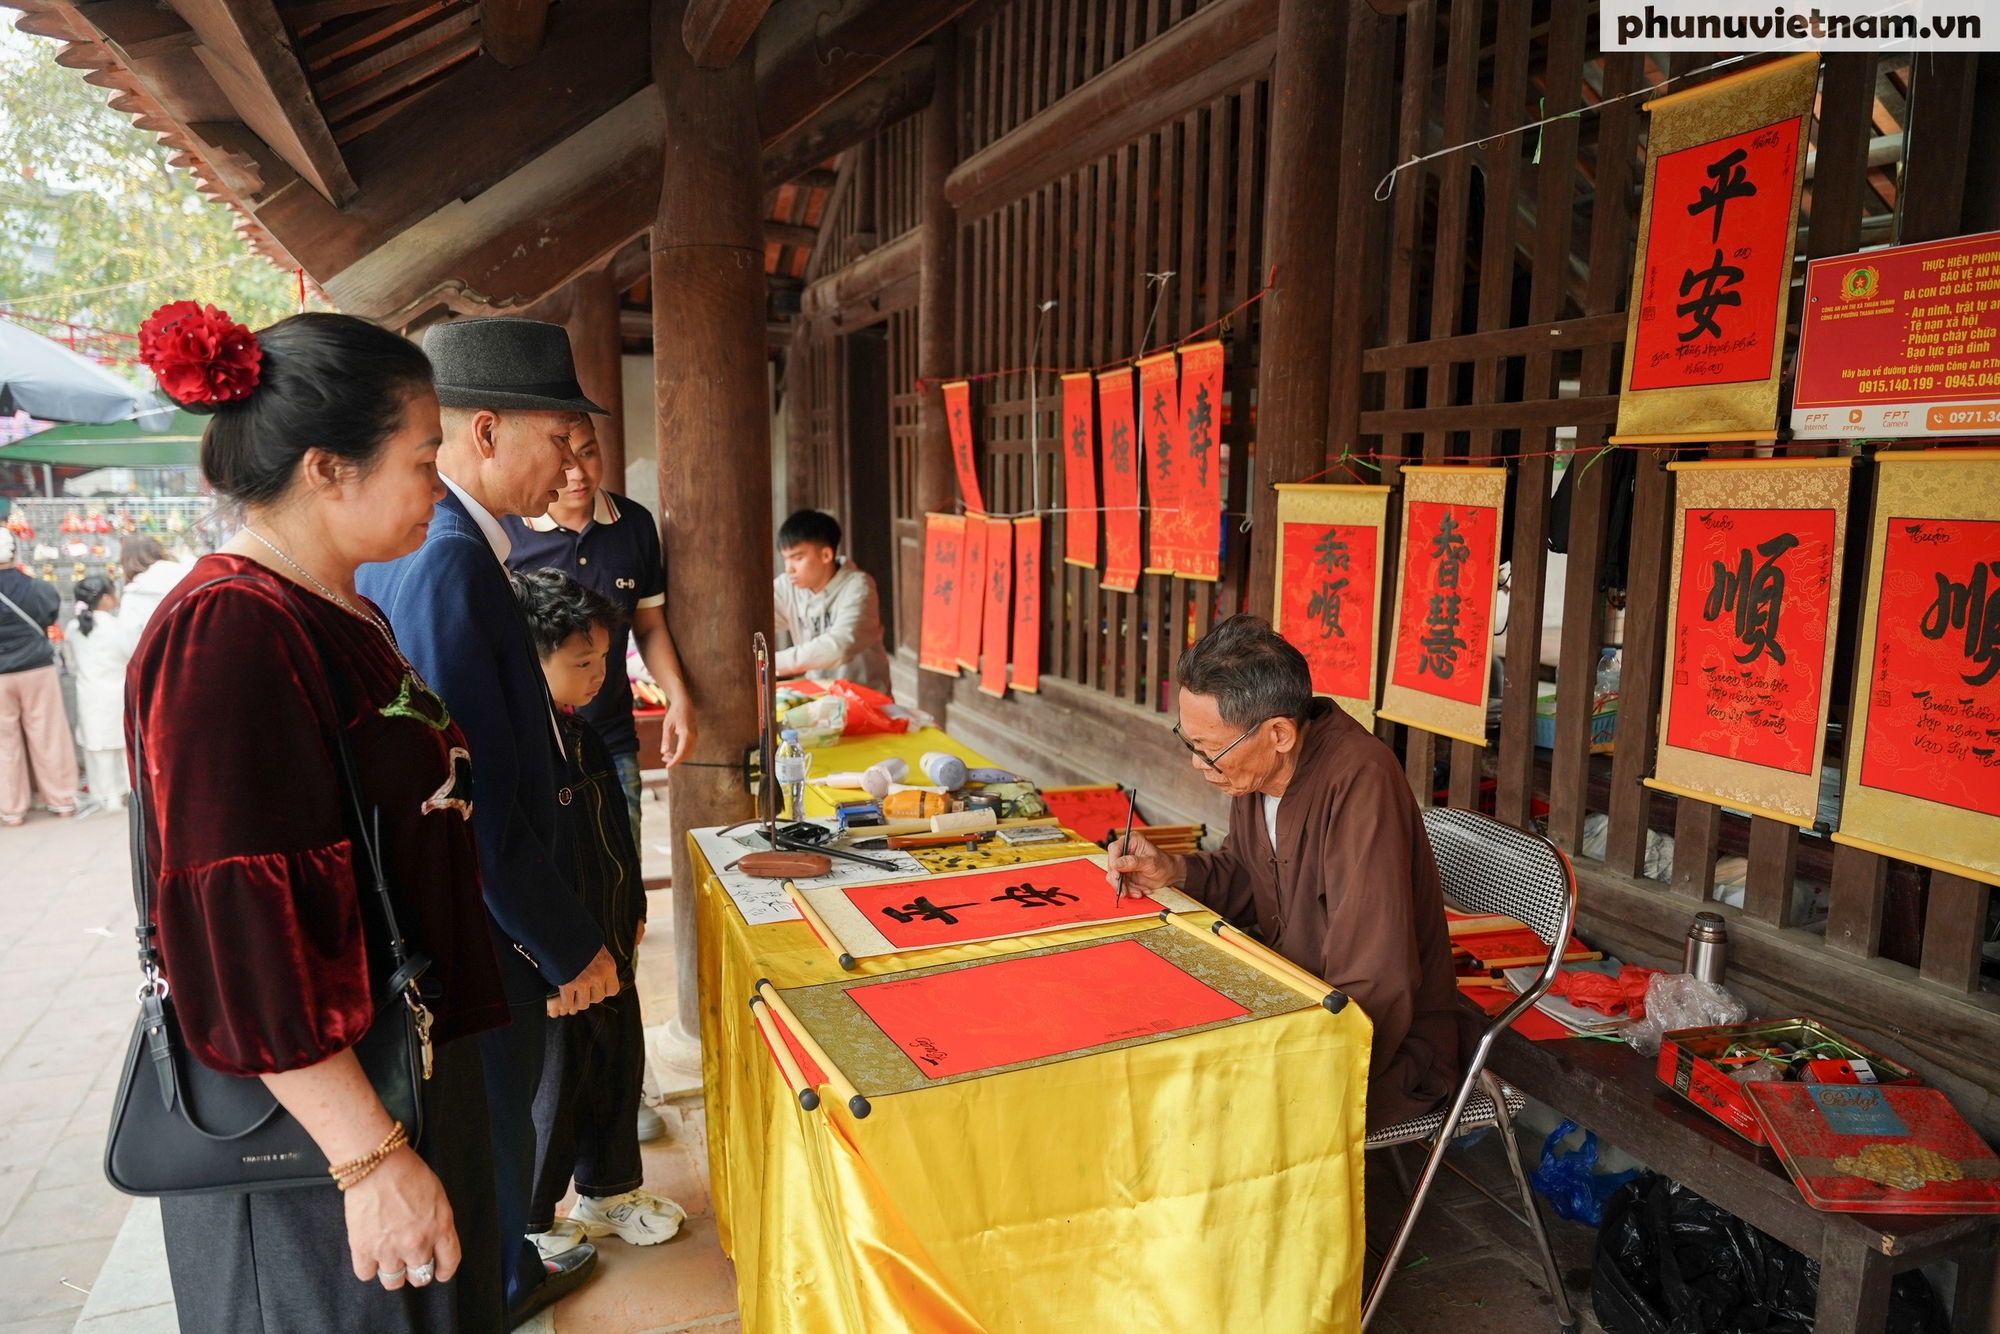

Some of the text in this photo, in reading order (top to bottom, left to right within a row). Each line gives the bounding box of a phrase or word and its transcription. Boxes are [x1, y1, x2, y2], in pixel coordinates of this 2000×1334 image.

[1676, 147, 1757, 343] 平安
[1922, 258, 1945, 273] THỰC
[1947, 254, 1969, 269] HIỆN
[1940, 267, 1959, 283] BẢO
[1961, 266, 1973, 281] VỆ
[1975, 266, 1989, 278] AN
[1903, 277, 2000, 301] BÀ CON CÓ CÁC THÔN
[1911, 306, 1925, 319] An
[1927, 303, 1952, 316] ninh,
[1956, 301, 1974, 315] trật
[1977, 300, 1989, 314] tự
[1910, 320, 1922, 333] Tệ
[1924, 319, 1944, 332] nạn
[1945, 316, 1959, 328] xã
[1961, 314, 1979, 329] hội
[1908, 333, 1940, 345] Phòng
[1942, 328, 1968, 342] cháy
[1970, 327, 1997, 340] chữa
[1906, 347, 1926, 360] Bạo
[1928, 345, 1945, 359] lực
[1947, 343, 1964, 356] gia
[1966, 341, 1991, 354] đình
[1908, 364, 1922, 374] dây
[1924, 363, 1944, 373] nóng
[1946, 361, 1967, 371] Công
[1969, 360, 1981, 370] An
[1858, 376, 1934, 394] 0915.140.199
[1806, 414, 1829, 422] FPT
[1883, 411, 1910, 420] FPT
[1883, 420, 1909, 428] Camera
[1804, 423, 1828, 431] Internet
[1307, 528, 1350, 639] 和順
[1418, 509, 1471, 680] 智慧
[1703, 532, 1799, 666] 順
